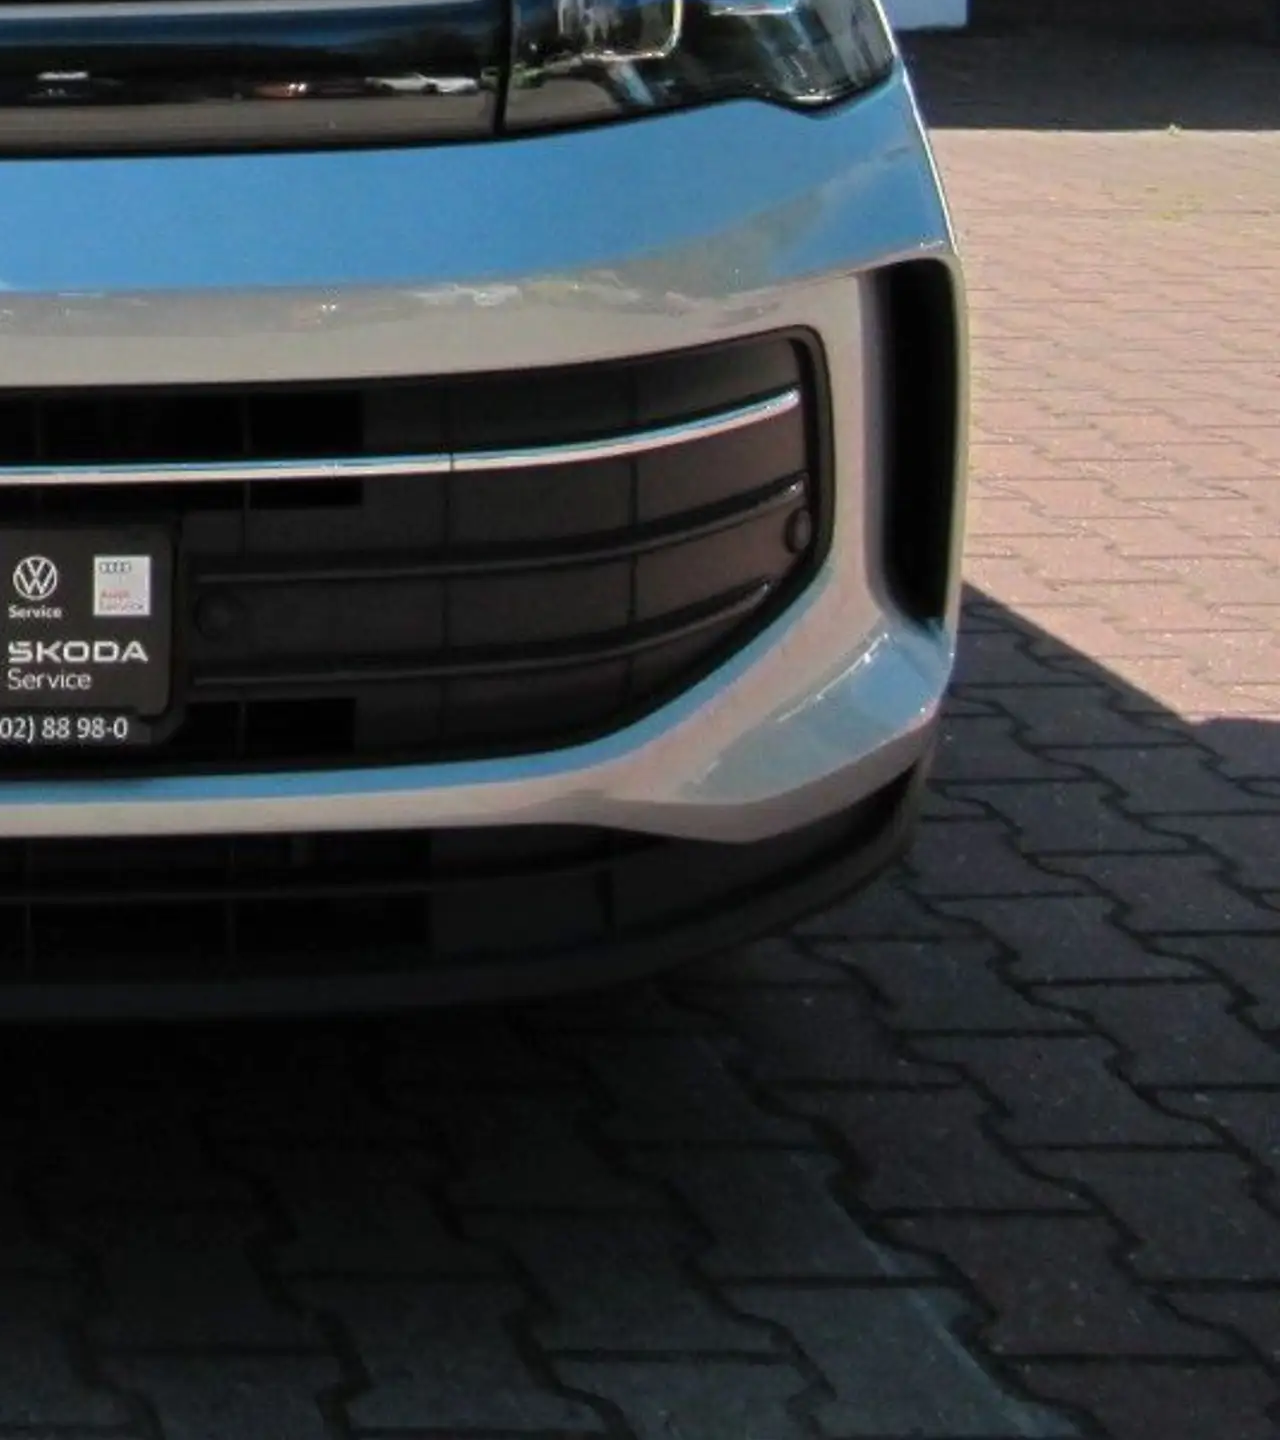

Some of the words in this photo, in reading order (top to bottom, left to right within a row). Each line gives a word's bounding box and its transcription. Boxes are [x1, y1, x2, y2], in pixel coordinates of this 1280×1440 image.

[8, 605, 63, 619] Service
[7, 667, 92, 690] Service
[42, 717, 71, 740] 88
[77, 717, 128, 740] 98-0
